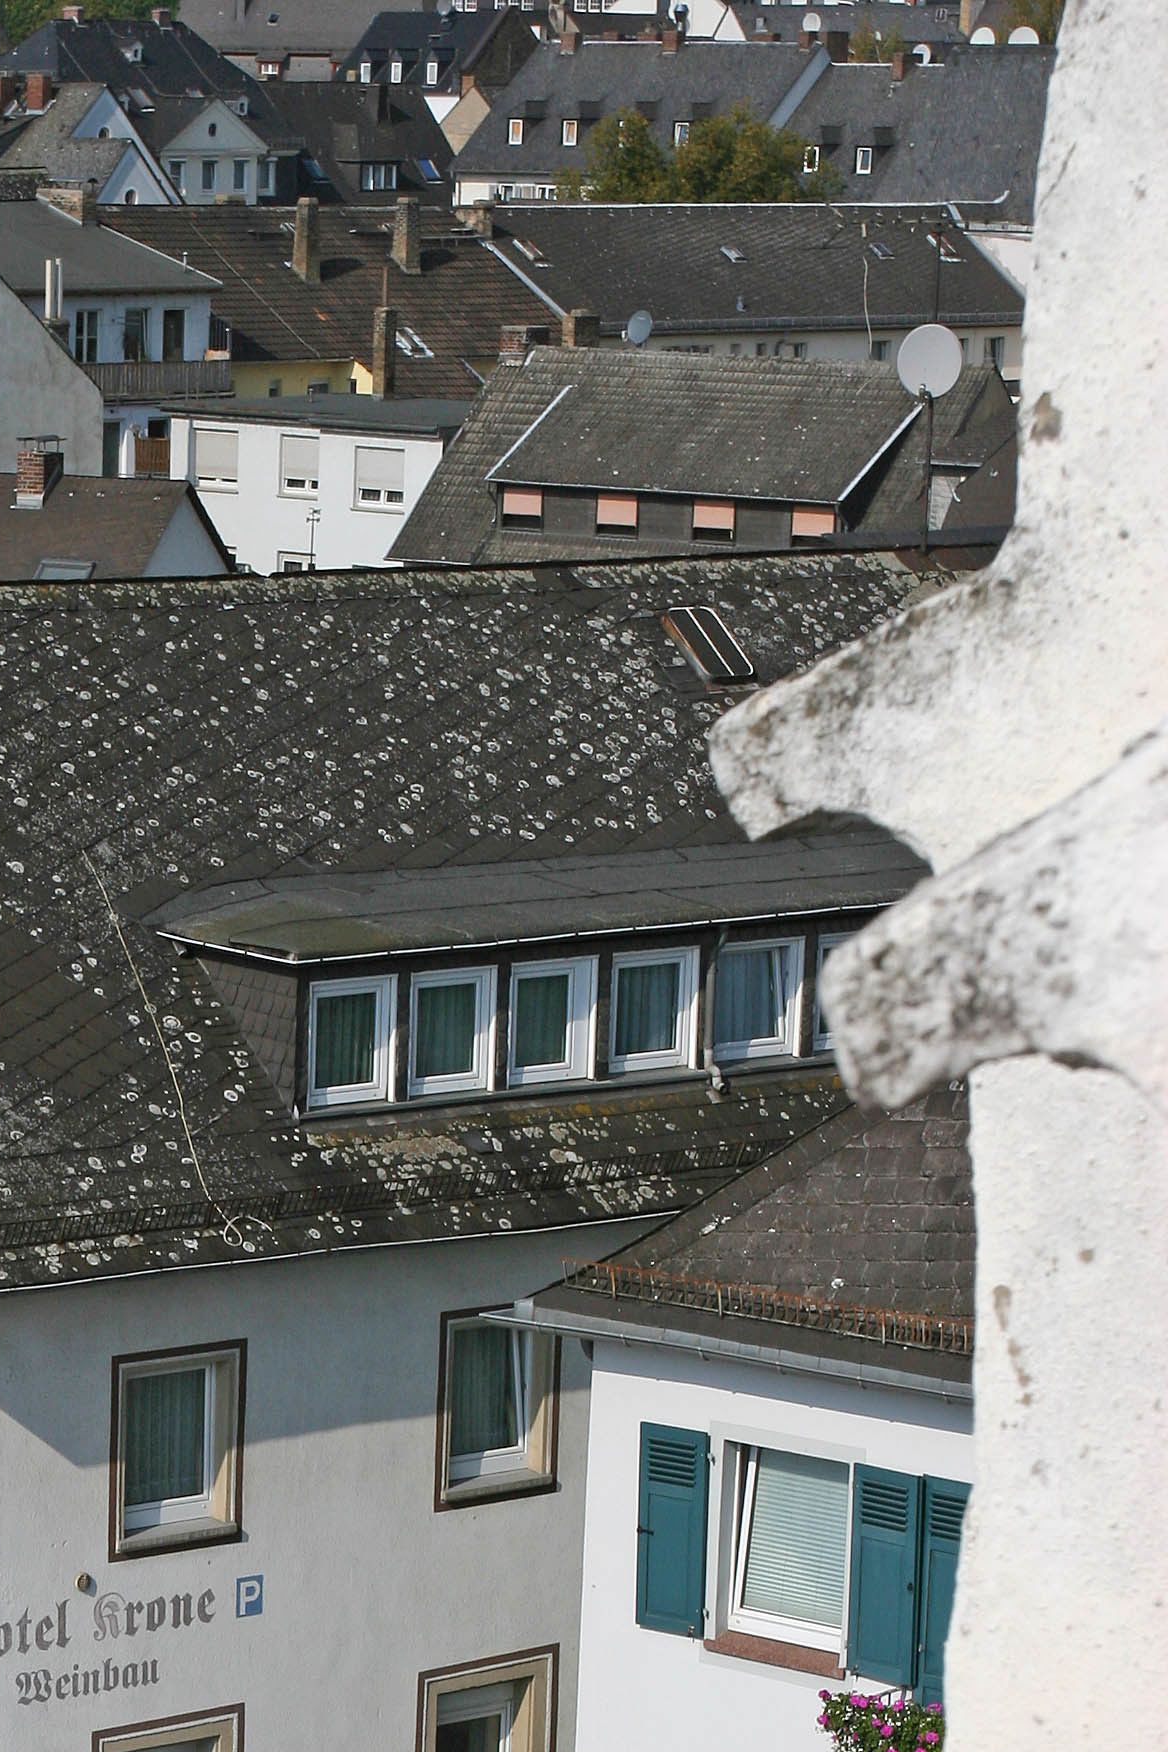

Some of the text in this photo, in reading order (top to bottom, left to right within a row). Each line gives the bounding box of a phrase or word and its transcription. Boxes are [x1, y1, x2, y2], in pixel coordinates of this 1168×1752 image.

[93, 1588, 217, 1642] Krone
[238, 1579, 261, 1618] P
[15, 1657, 161, 1706] Weinbau
